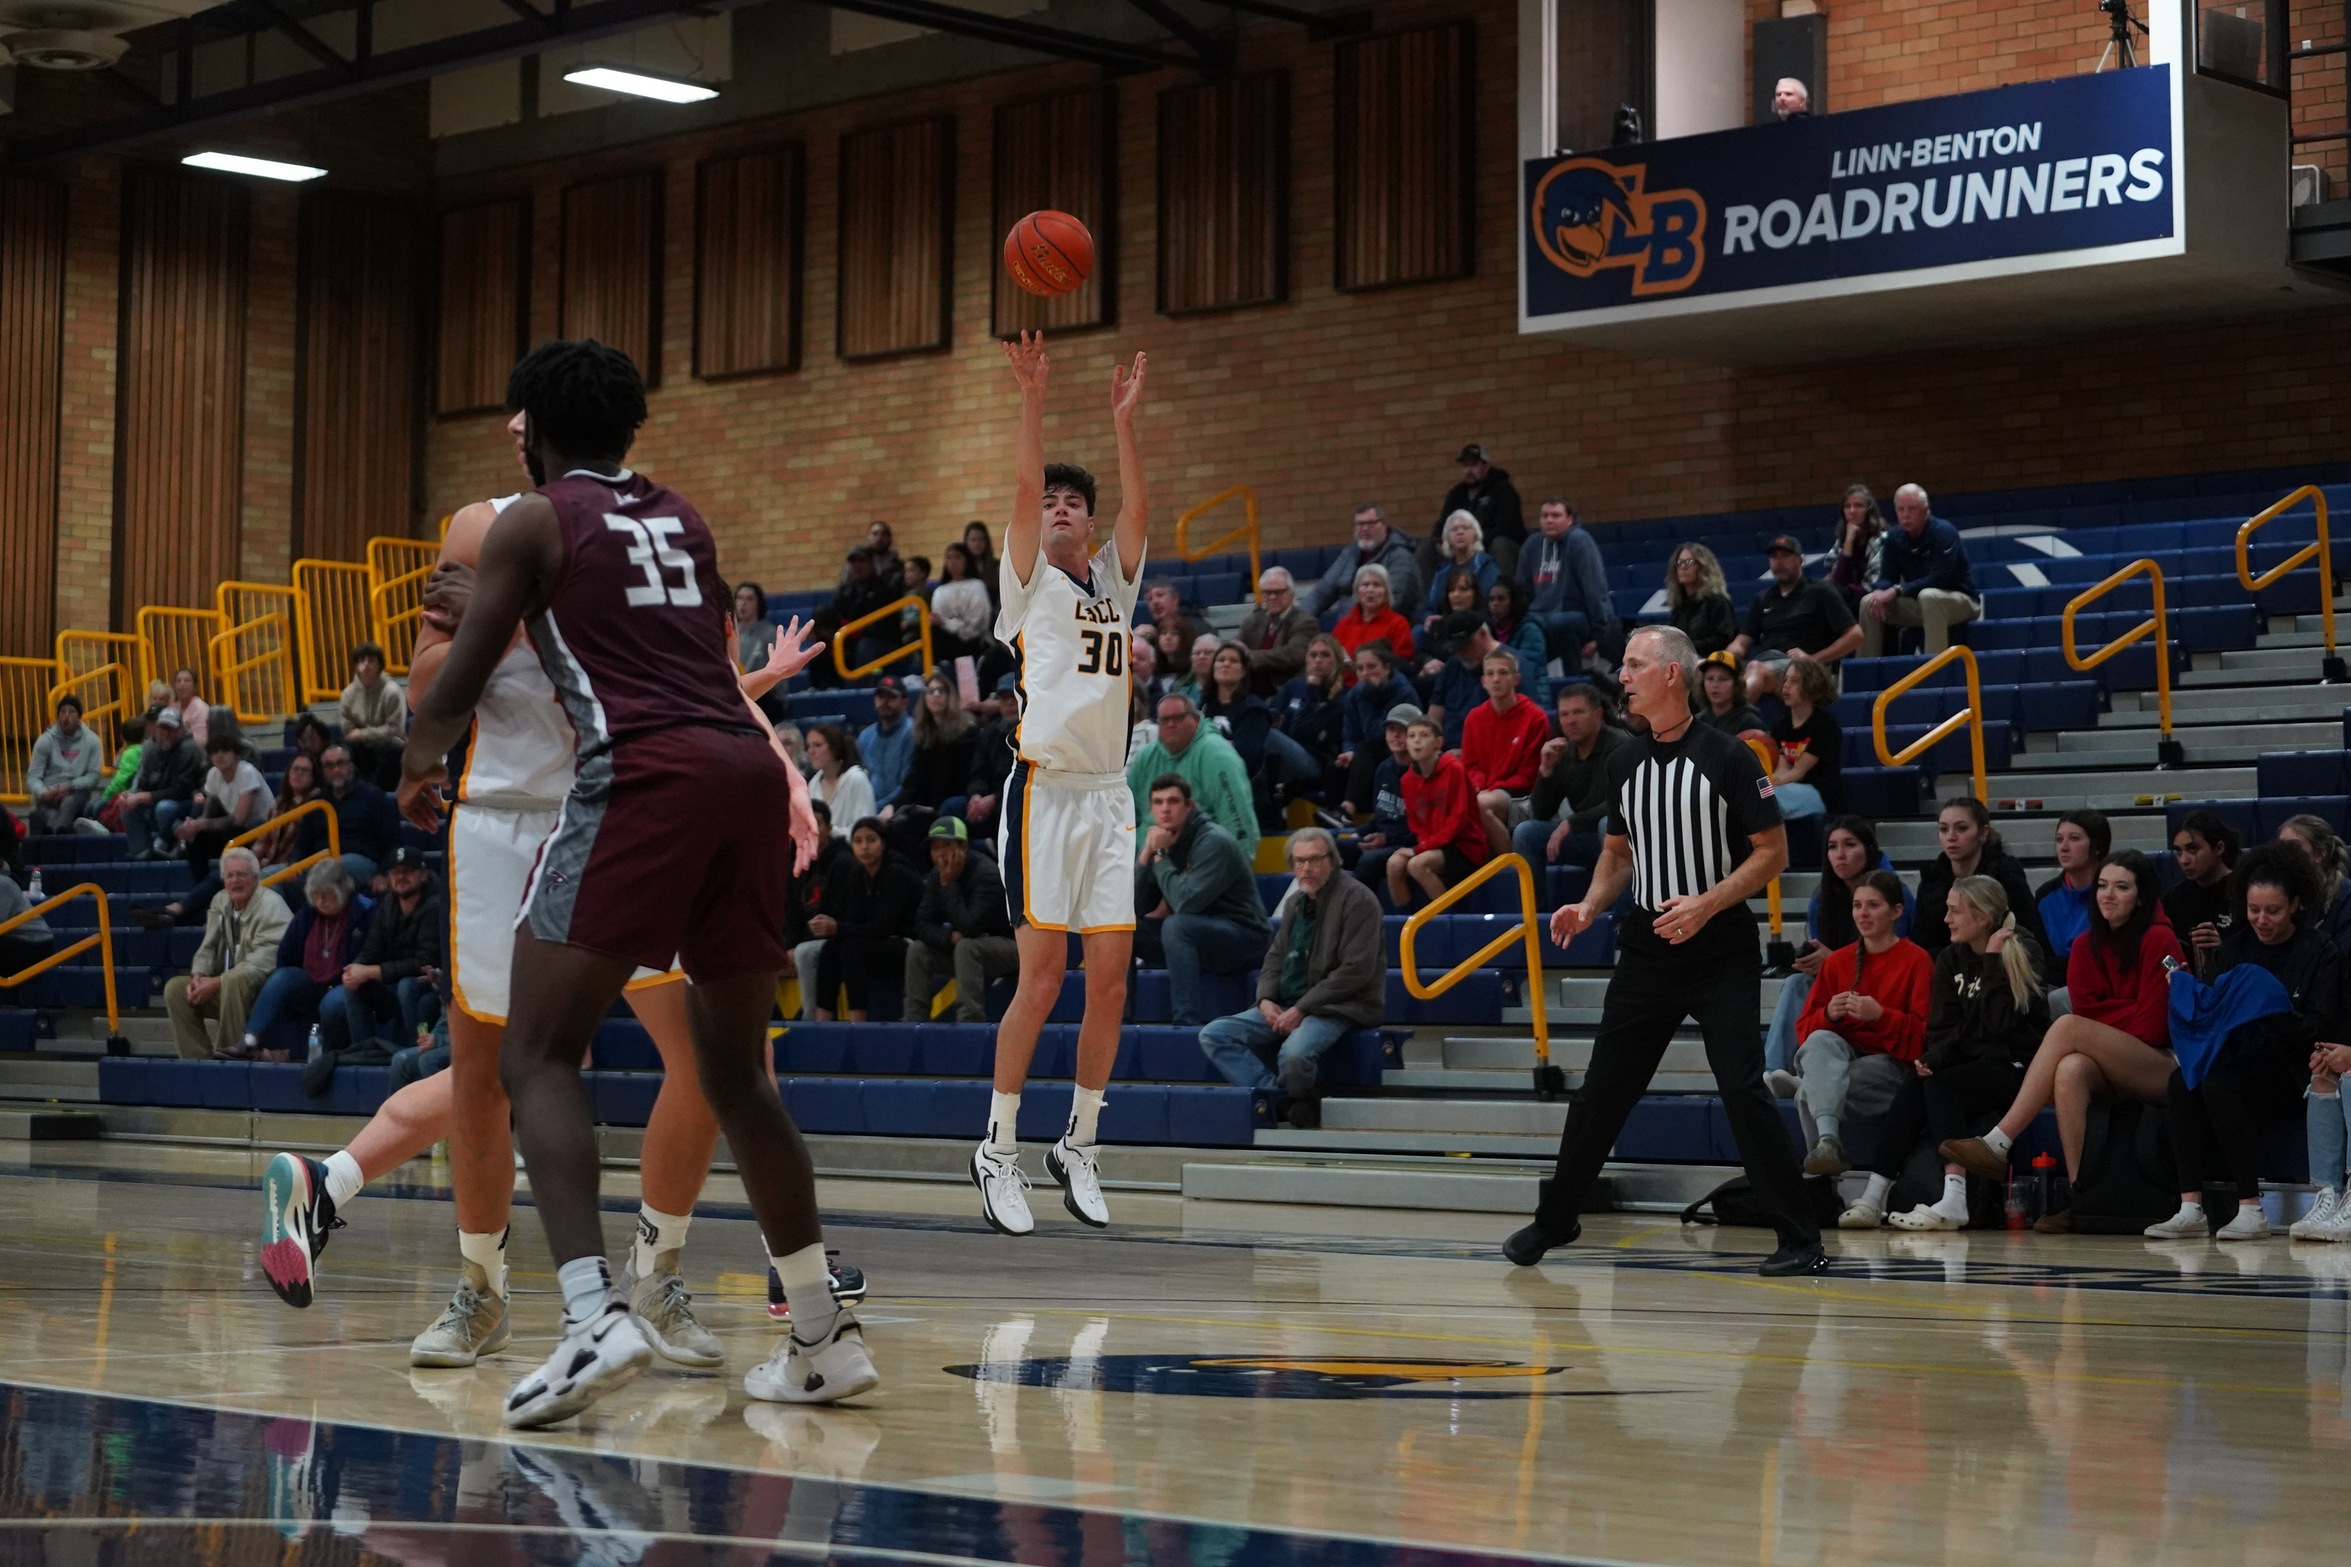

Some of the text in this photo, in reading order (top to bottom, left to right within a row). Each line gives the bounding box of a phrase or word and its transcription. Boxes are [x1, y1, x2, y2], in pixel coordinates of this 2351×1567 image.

[1831, 121, 2042, 179] LINN-BENTON
[1722, 147, 2165, 256] ROADRUNNERS
[602, 512, 703, 607] 35
[1077, 629, 1123, 677] 30
